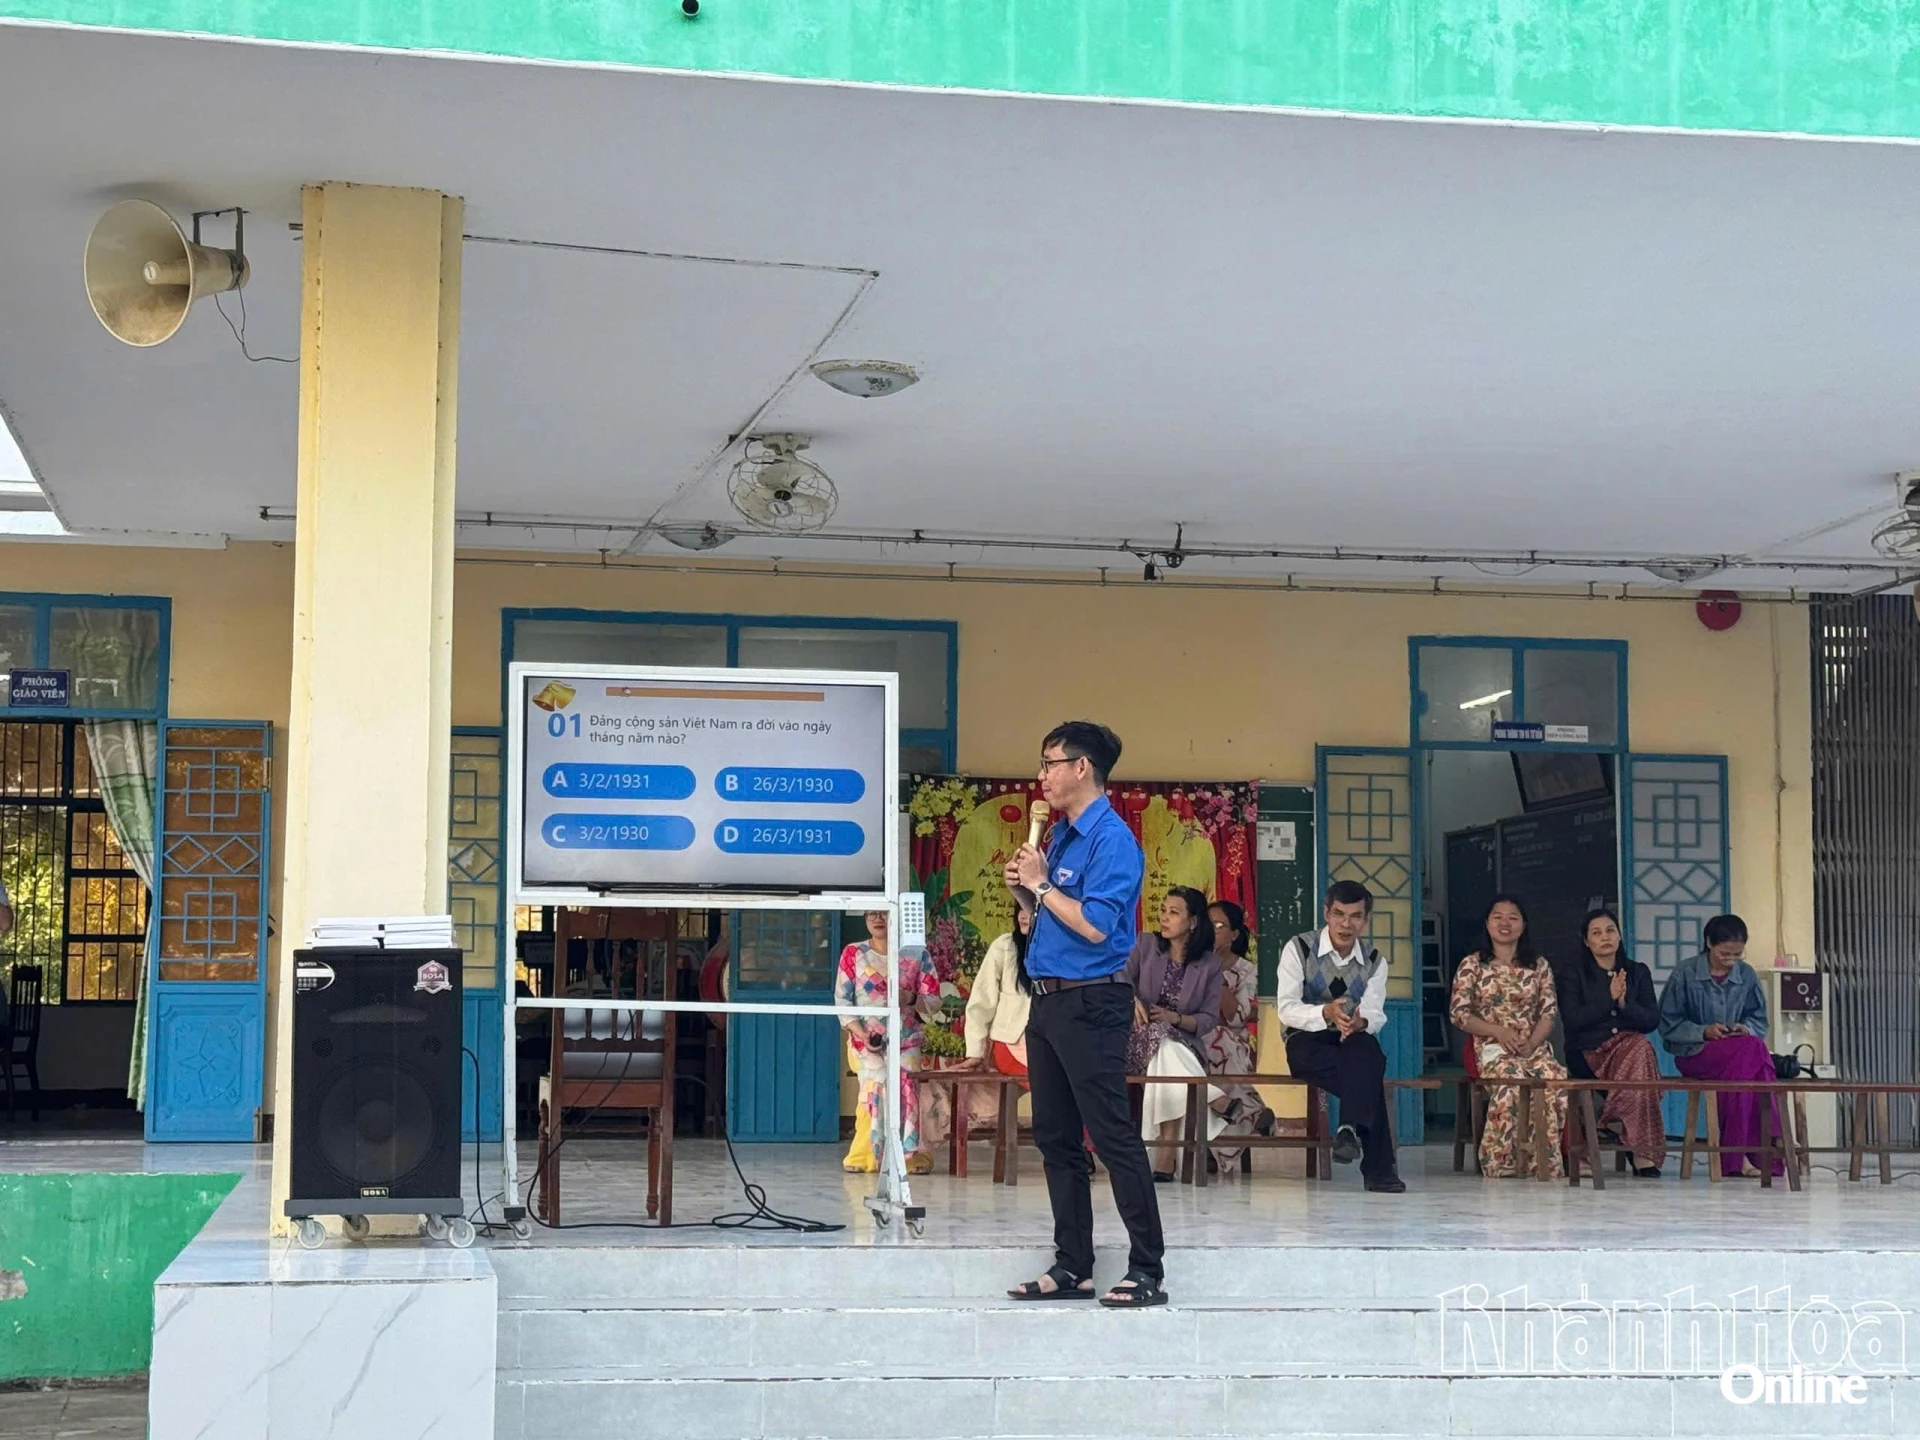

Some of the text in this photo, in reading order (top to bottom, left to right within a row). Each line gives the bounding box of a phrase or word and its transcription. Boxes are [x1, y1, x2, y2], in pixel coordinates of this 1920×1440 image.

[22, 676, 58, 687] PHÒNG
[12, 687, 66, 699] GIÁO VIÊN
[547, 712, 581, 738] 01
[589, 714, 832, 735] Đảng cộng sản Việt Nam ra đời vào ngày
[589, 731, 687, 746] tháng năm nào?
[551, 770, 650, 790] A 3/2/1931
[725, 774, 834, 794] B 26/3/1930
[551, 824, 650, 843] C 3/2/1930
[723, 825, 833, 845] D 26/3/1931
[422, 972, 444, 981] BOSA
